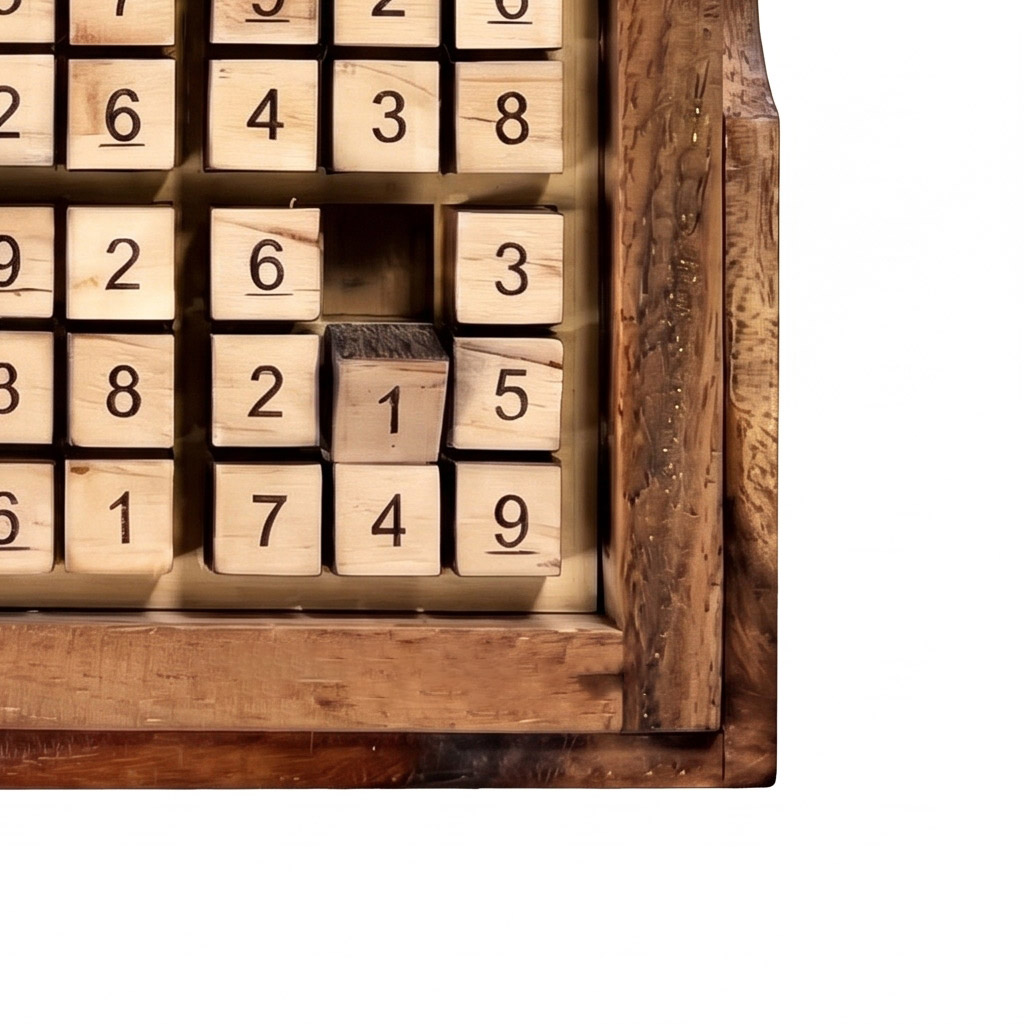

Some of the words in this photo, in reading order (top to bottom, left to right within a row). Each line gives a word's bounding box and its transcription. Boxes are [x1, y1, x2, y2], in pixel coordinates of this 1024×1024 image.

[105, 89, 140, 142] 6
[247, 89, 284, 140] 4
[373, 91, 406, 143] 3
[496, 92, 529, 145] 8
[106, 239, 139, 290] 2
[250, 239, 284, 290] 6
[496, 242, 528, 296] 3
[107, 365, 141, 418] 8
[248, 366, 283, 417] 2
[378, 386, 400, 434] 1
[496, 369, 528, 420] 5
[110, 491, 129, 544] 1
[253, 495, 287, 546] 7
[372, 494, 406, 546] 4
[495, 495, 528, 548] 9
